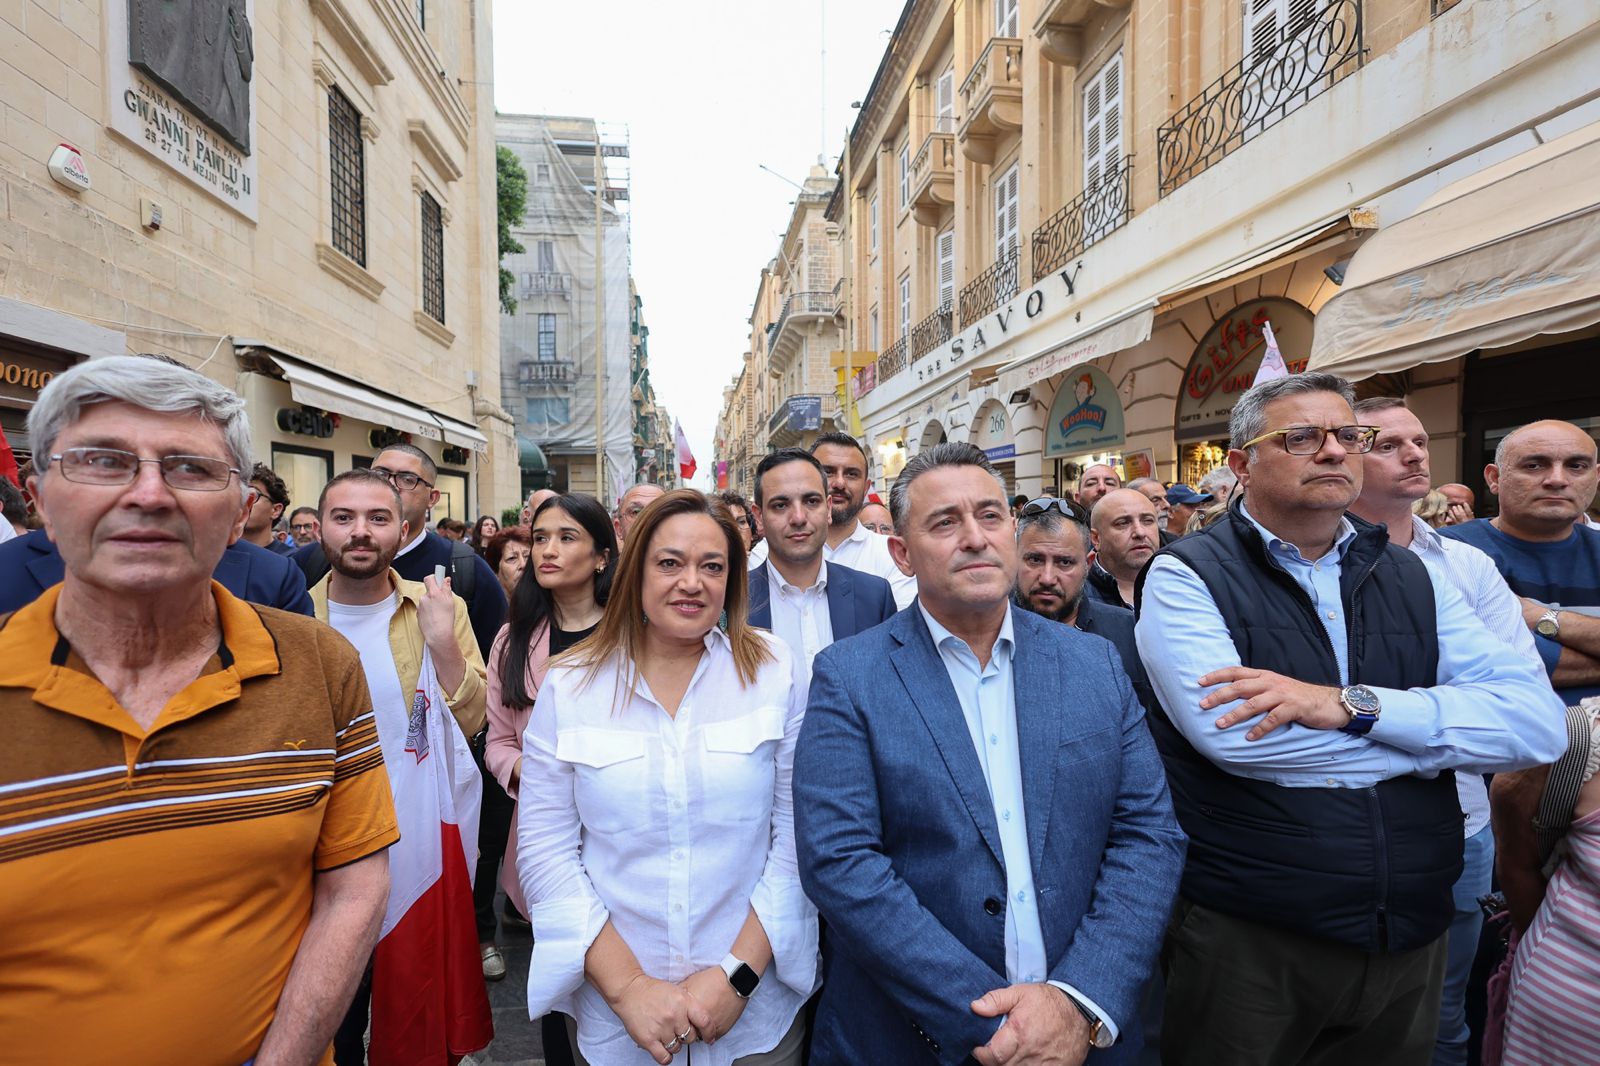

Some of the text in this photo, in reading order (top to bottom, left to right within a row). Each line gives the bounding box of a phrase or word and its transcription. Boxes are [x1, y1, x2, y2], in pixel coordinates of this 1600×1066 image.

[196, 139, 238, 184] PAWLU
[242, 173, 250, 195] II
[223, 145, 242, 168] PAPA
[63, 166, 89, 184] alberta
[222, 182, 239, 200] 1990
[950, 259, 1084, 363] SAVOY
[990, 412, 1005, 433] 266
